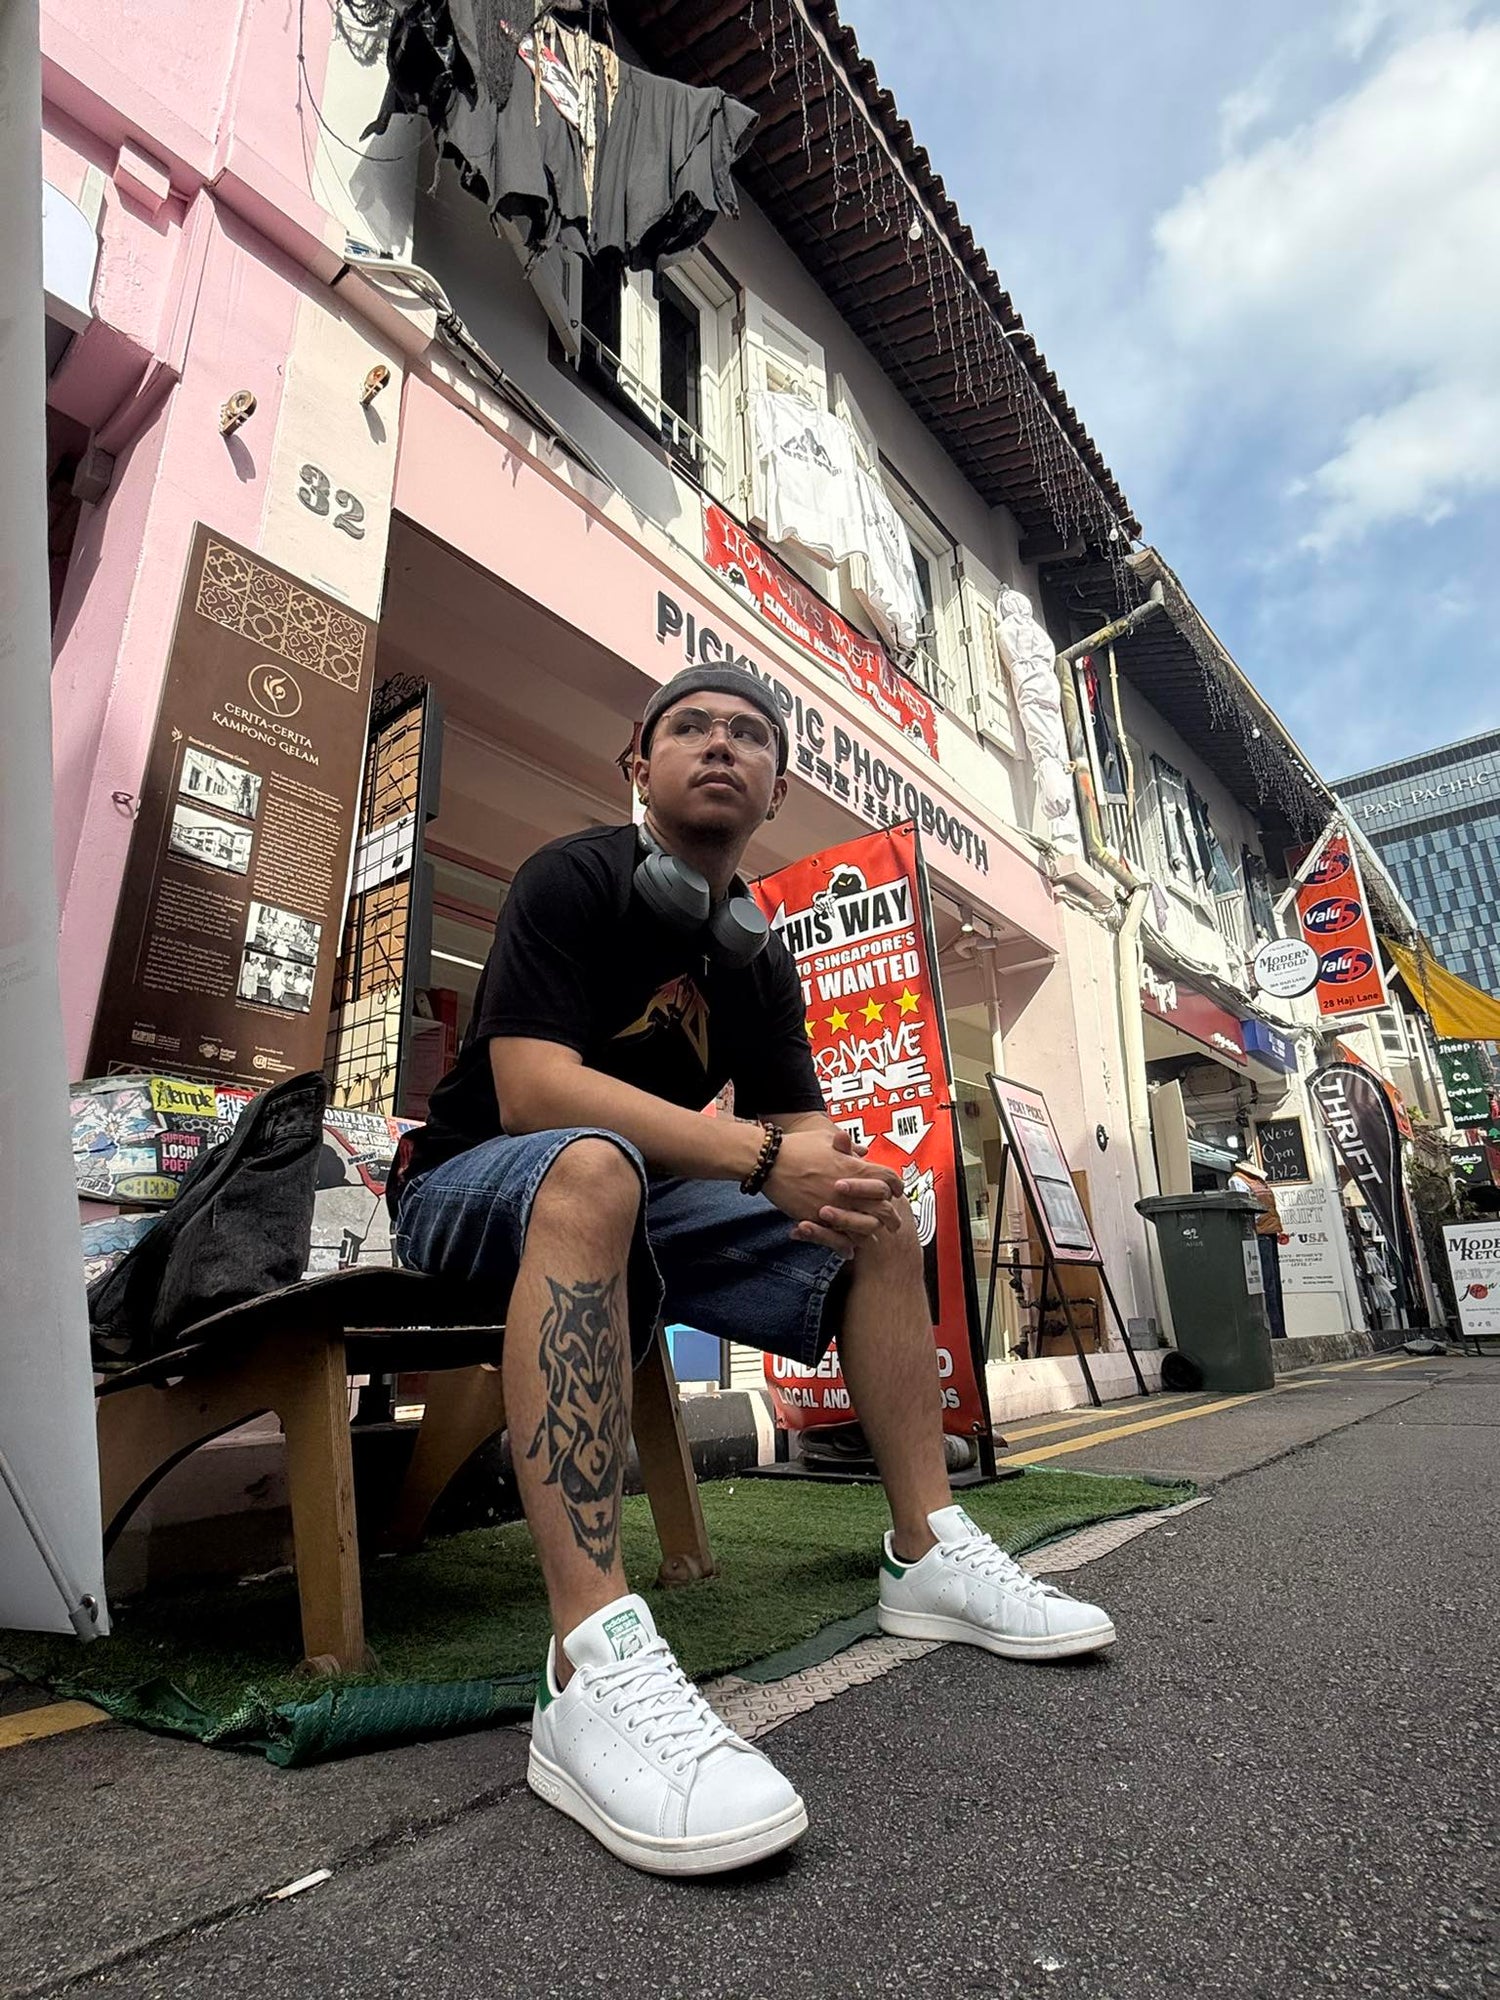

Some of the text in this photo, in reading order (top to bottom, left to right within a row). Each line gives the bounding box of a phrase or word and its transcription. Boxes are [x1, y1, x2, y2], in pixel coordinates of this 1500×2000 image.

[297, 463, 366, 540] 32
[212, 711, 319, 766] KAMPONG GELAM
[224, 702, 313, 749] CERITA-CERITA
[833, 725, 988, 871] PHOTOBOOTH
[1363, 771, 1491, 819] PAN PACIFIC
[838, 884, 907, 937] WAY
[814, 931, 916, 972] SINGAPORE'S
[1260, 949, 1309, 968] MODERN
[1267, 958, 1306, 972] RETOLD
[816, 949, 920, 1002] WANTED
[1323, 993, 1378, 1008] 28 Haji Lane
[819, 1055, 932, 1102] CENE
[830, 1084, 933, 1116] ETPLACE
[161, 1133, 201, 1146] SUPPORT
[1318, 1077, 1383, 1184] THRIFT
[1262, 1143, 1295, 1163] Open
[1276, 1188, 1326, 1207] NTAGE
[1298, 1232, 1328, 1243] USA
[777, 1386, 850, 1410] LOCAL AND
